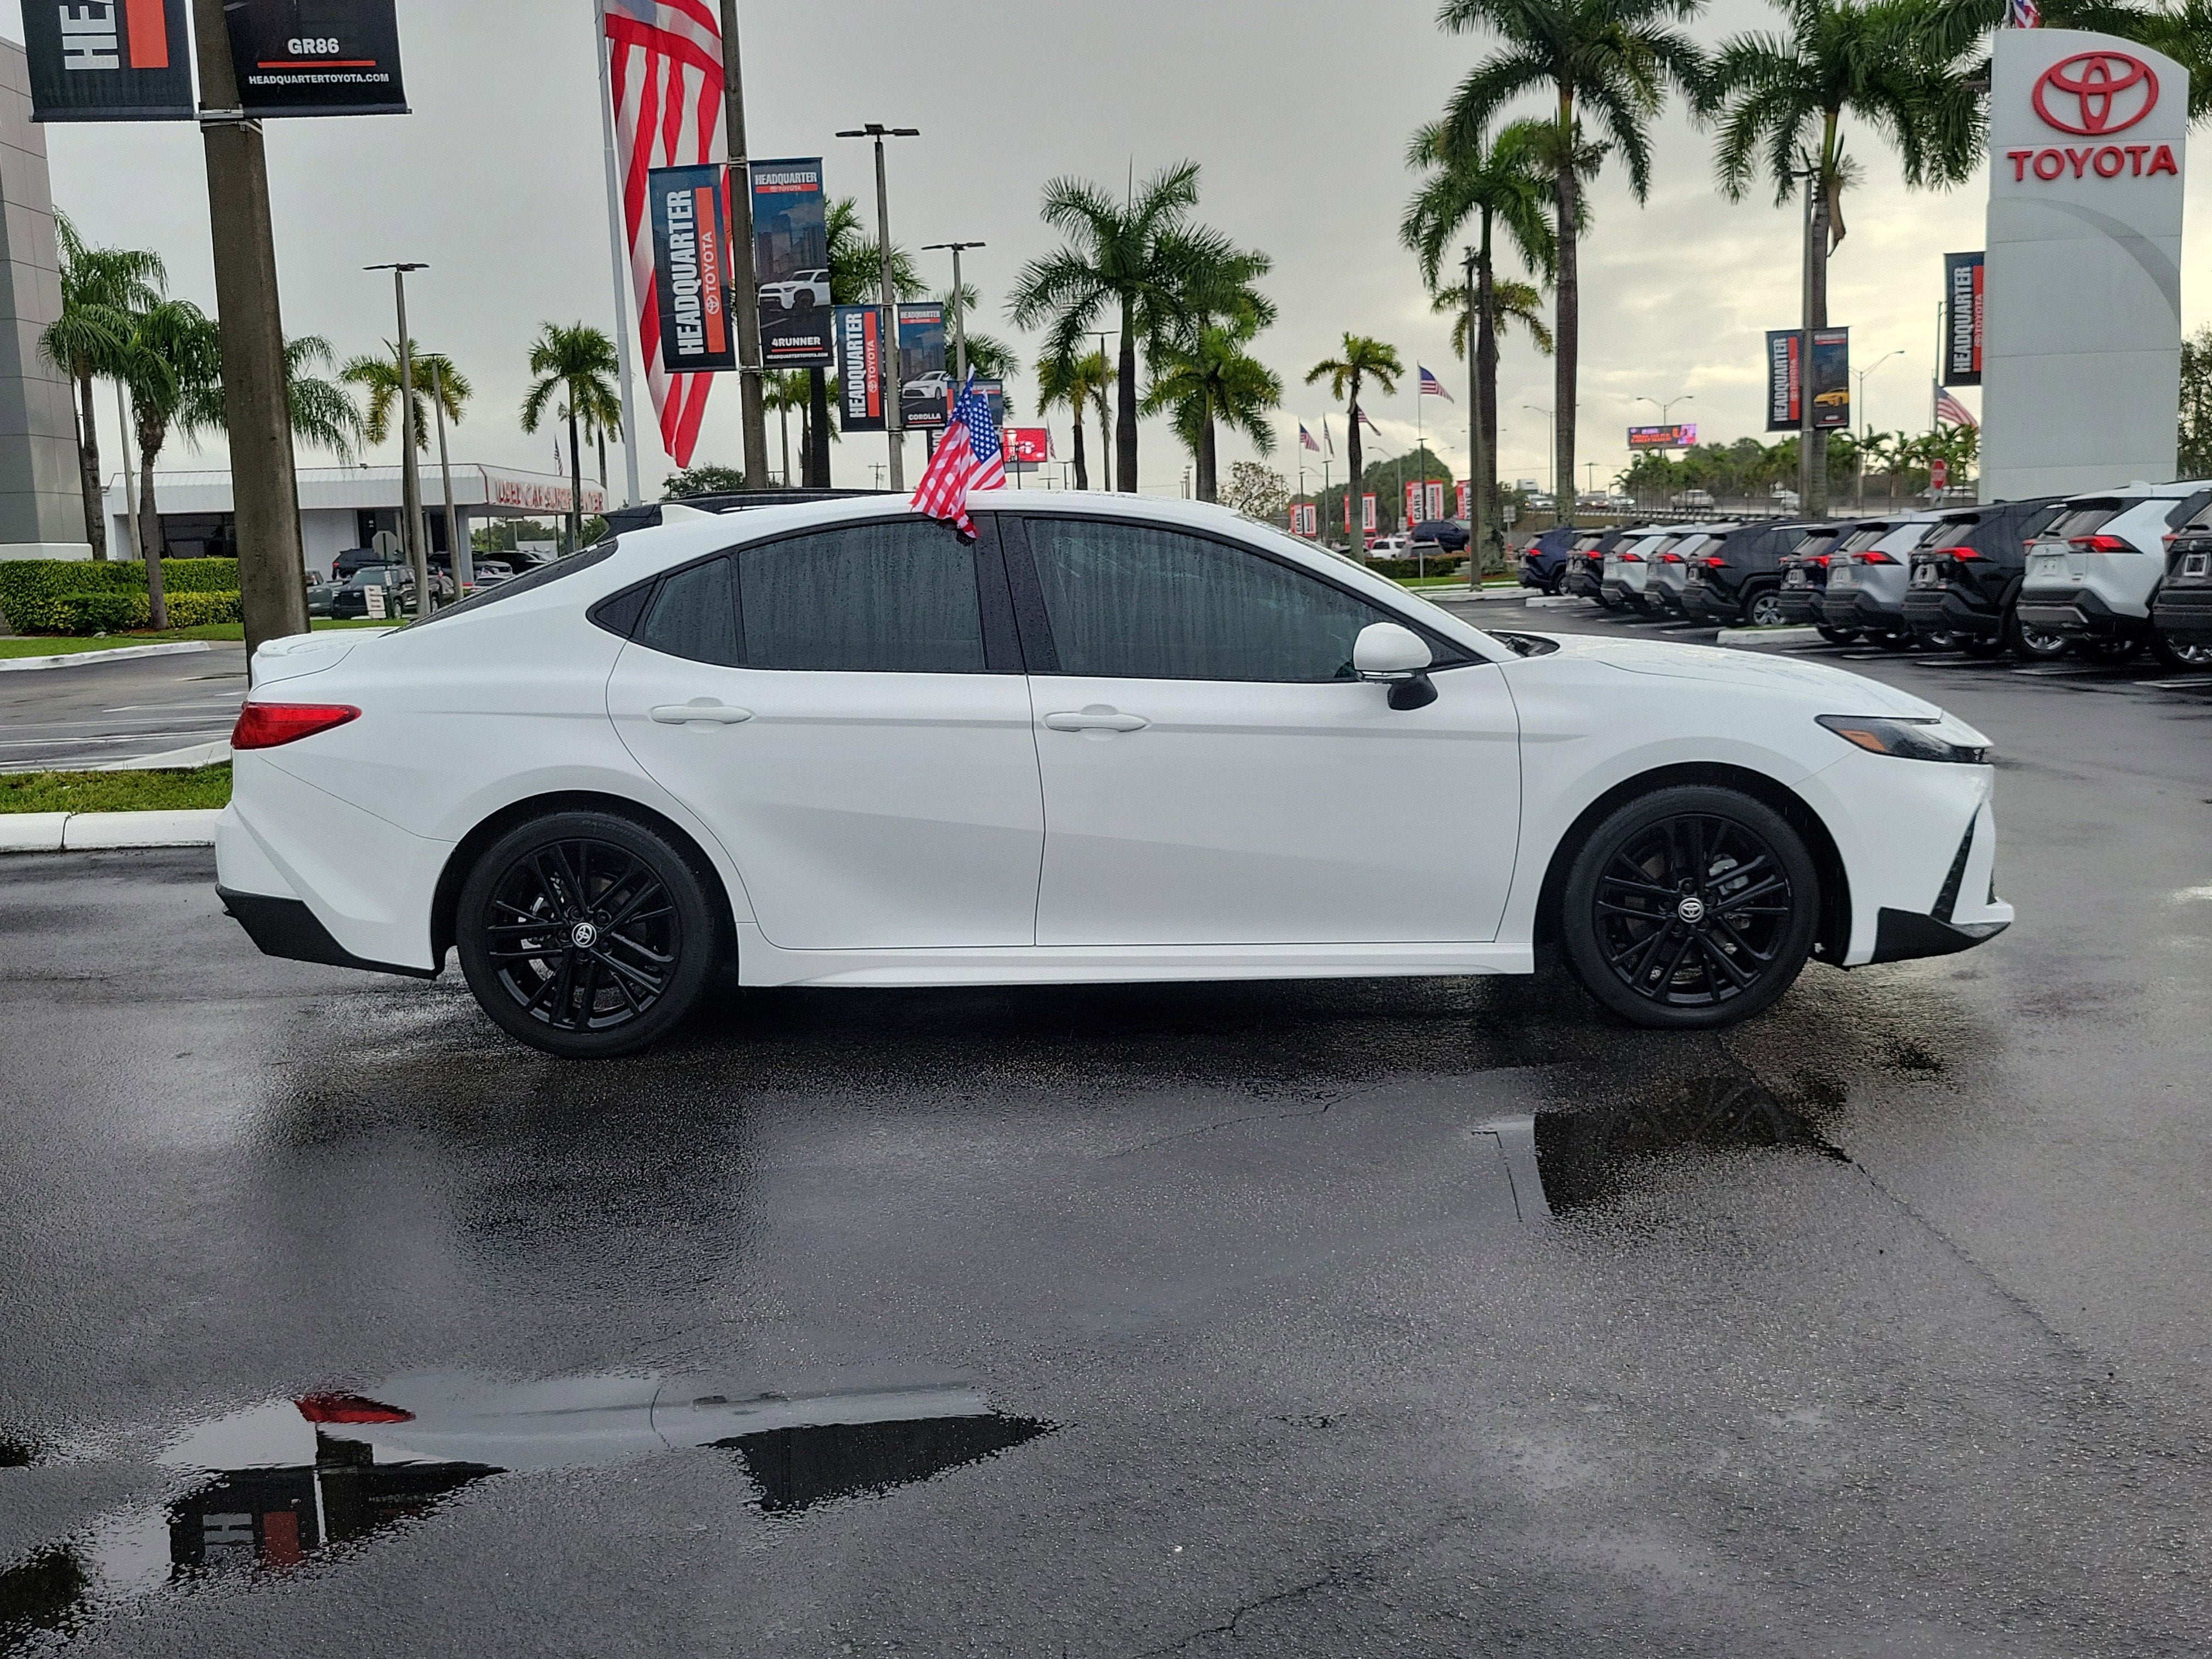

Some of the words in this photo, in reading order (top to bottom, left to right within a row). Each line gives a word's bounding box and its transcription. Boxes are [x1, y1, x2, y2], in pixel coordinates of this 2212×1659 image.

[288, 38, 340, 54] GR86
[249, 74, 389, 84] HEADQUARTERTOYOTA.COM
[755, 172, 817, 185] HEADQUARTER
[2007, 145, 2178, 182] TOYOTA
[667, 189, 704, 355] HEADQUARTER
[701, 231, 718, 294] TOYOTA
[1954, 266, 1973, 373] HEADQUARTER
[771, 336, 821, 347] 4RUNNER
[866, 340, 877, 380] TOYOTA
[845, 313, 866, 418] HEADQUARTER
[1773, 338, 1789, 421] HEADQUARTER
